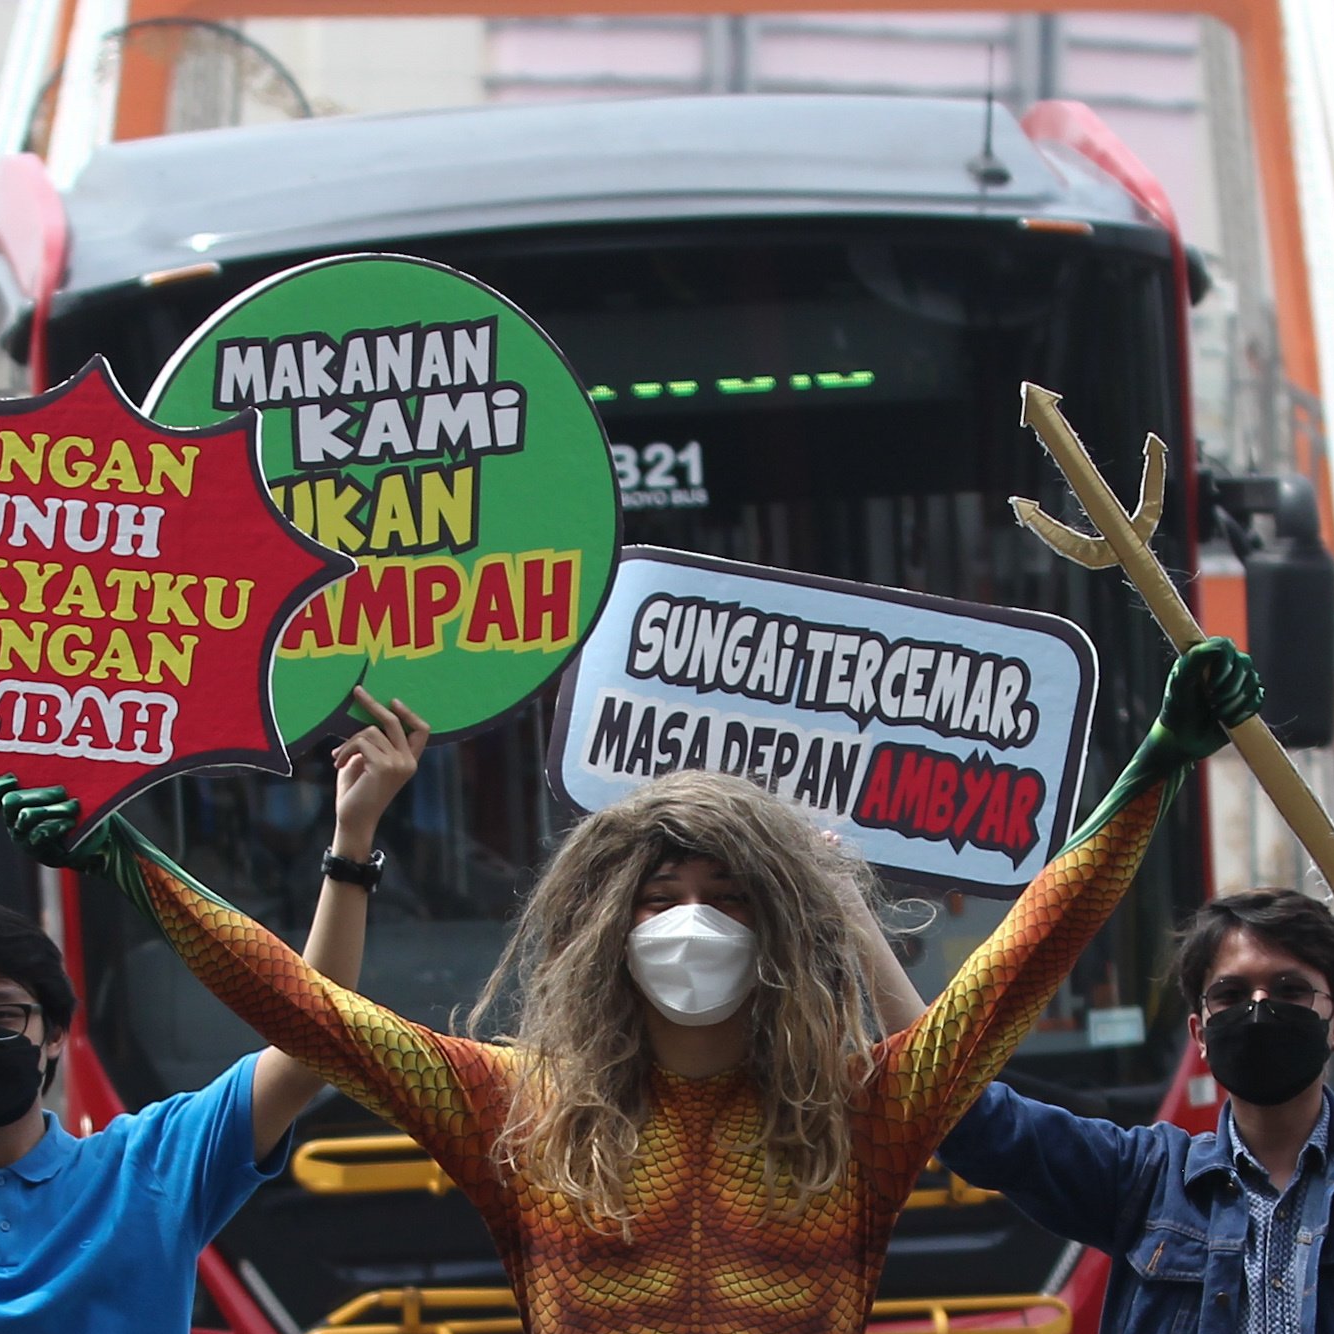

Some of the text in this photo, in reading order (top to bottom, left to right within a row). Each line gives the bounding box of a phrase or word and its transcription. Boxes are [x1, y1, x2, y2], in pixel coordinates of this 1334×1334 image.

[218, 324, 493, 405] MAKANAN
[270, 465, 474, 552] UKAN
[278, 557, 576, 652] AMPAH
[802, 629, 1035, 741] TERCEMAR,
[587, 696, 1041, 850] MASA DEPAN AMBYAR
